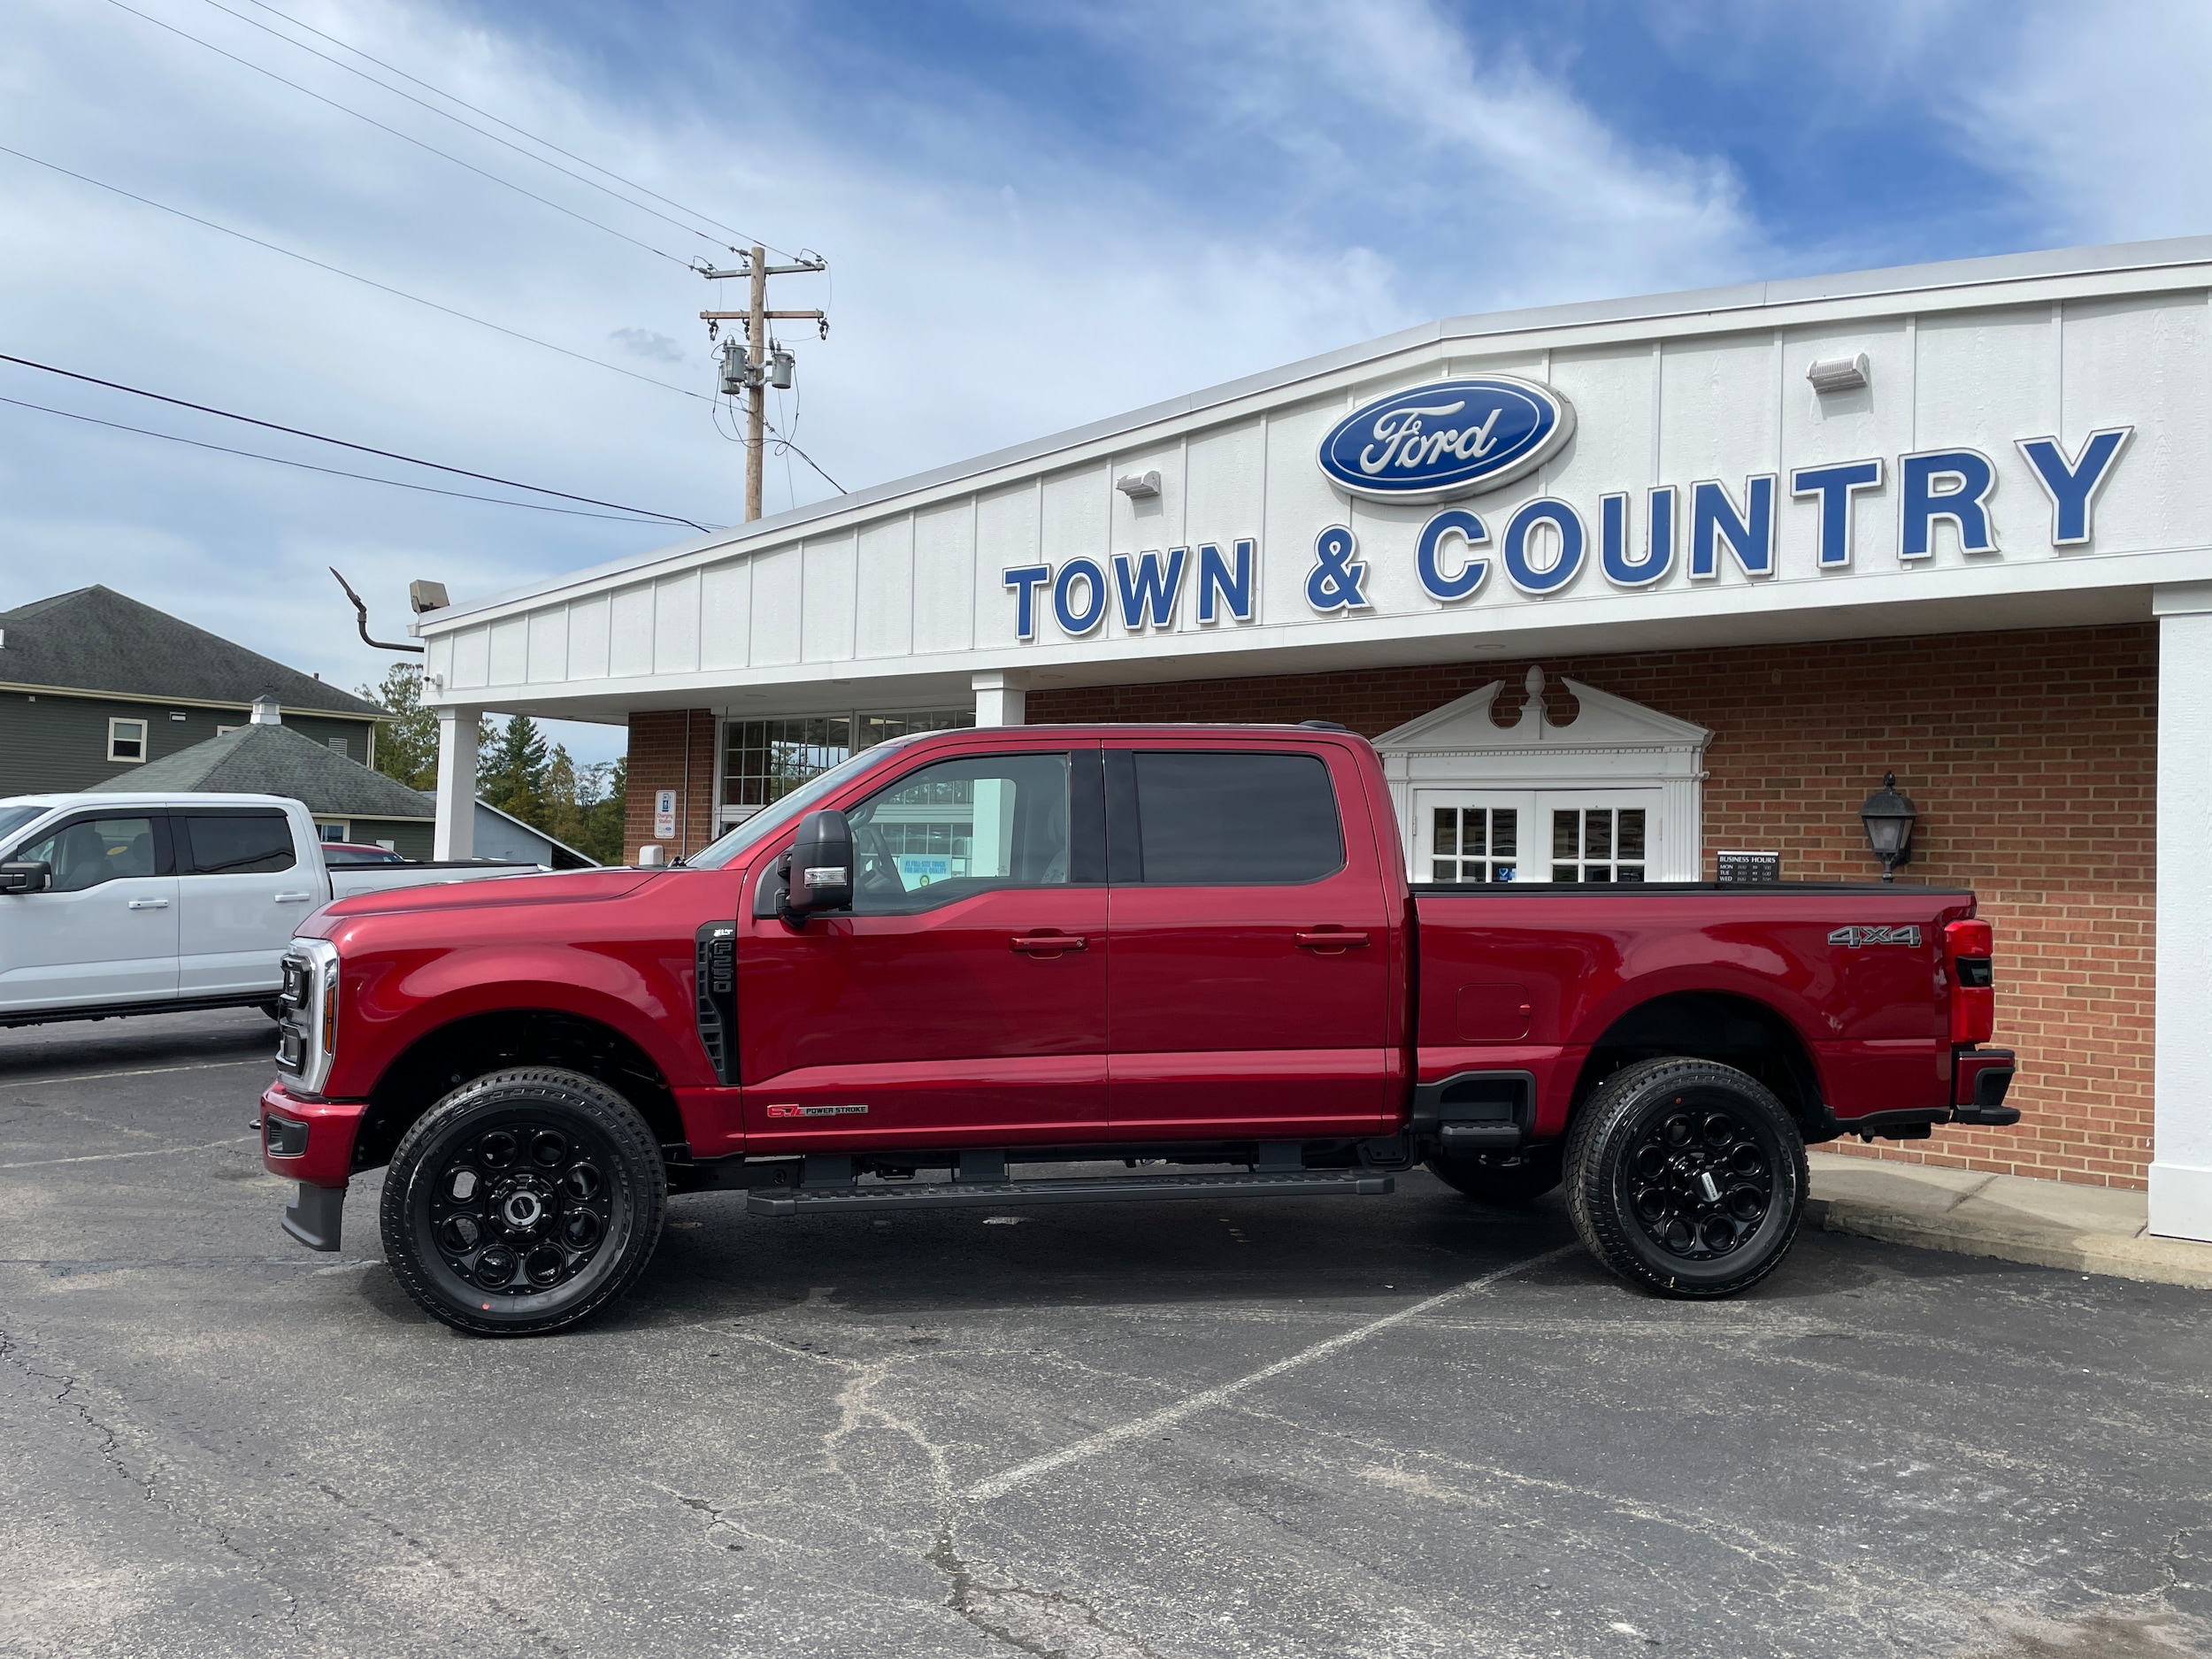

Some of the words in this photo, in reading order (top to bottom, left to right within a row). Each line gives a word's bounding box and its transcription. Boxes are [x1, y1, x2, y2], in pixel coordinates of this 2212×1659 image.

[1359, 401, 1502, 474] Ford
[1003, 537, 1256, 641] TOWN
[1305, 524, 1373, 613] &
[1415, 426, 2135, 603] COUNTRY
